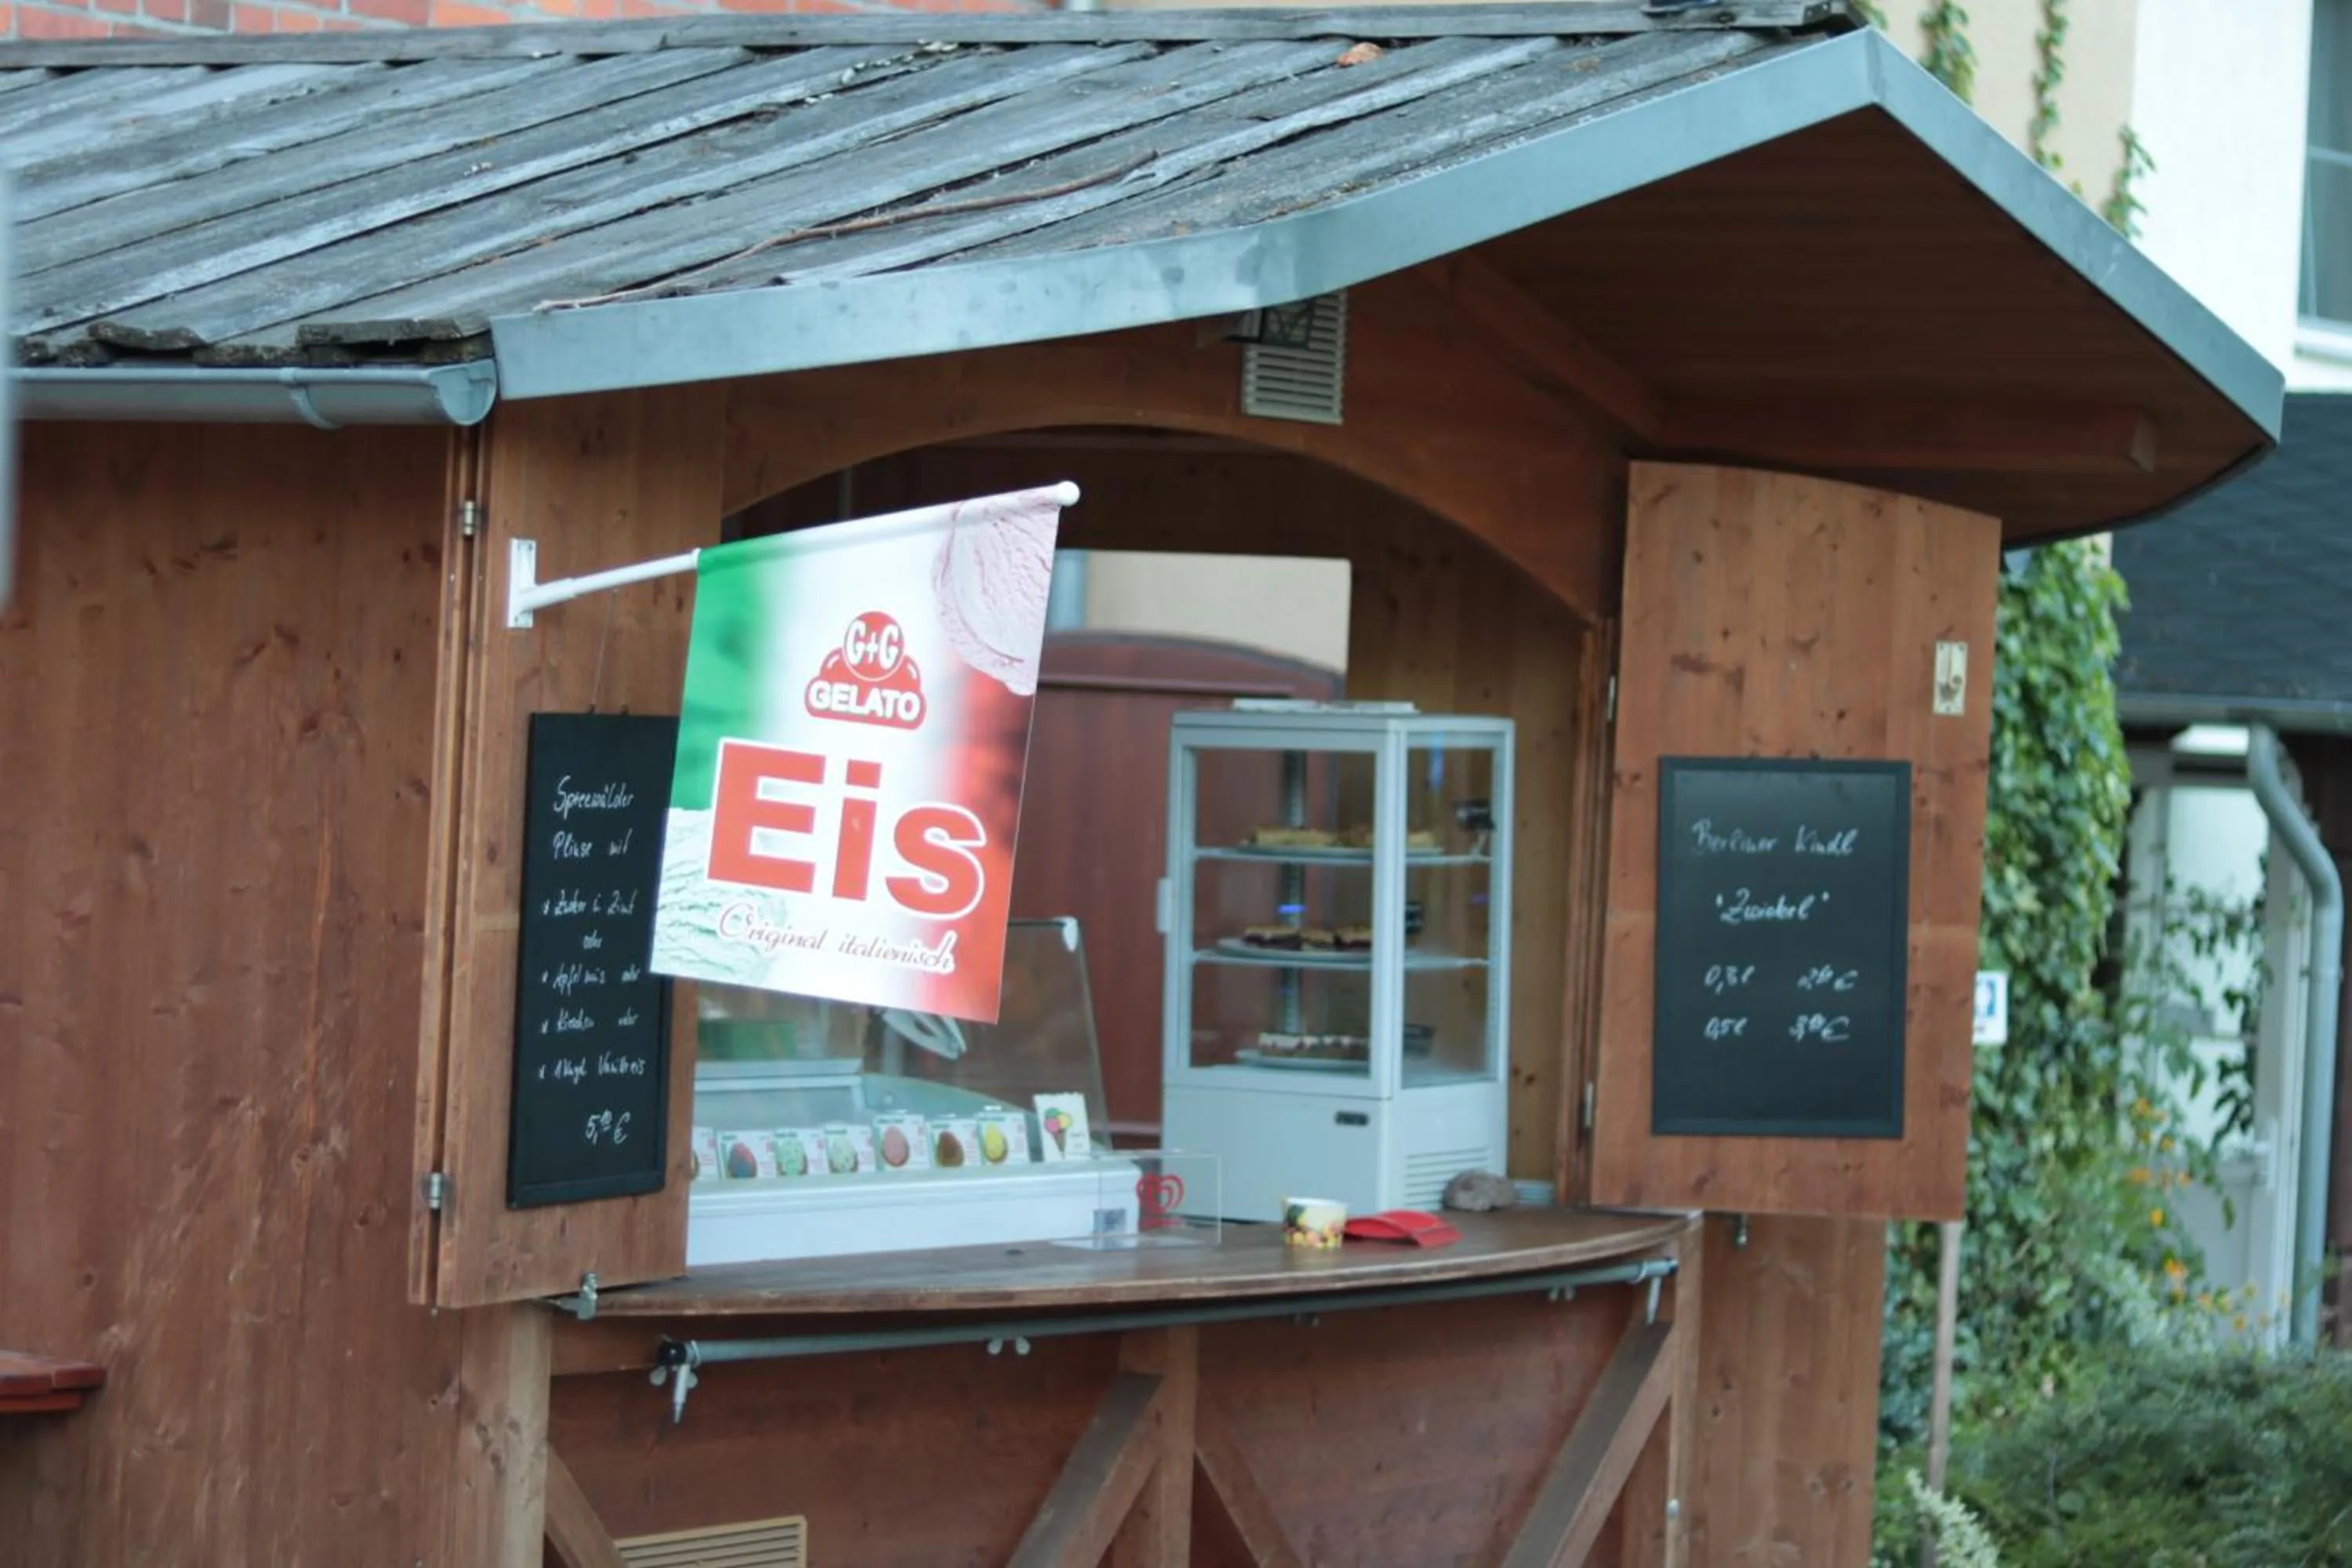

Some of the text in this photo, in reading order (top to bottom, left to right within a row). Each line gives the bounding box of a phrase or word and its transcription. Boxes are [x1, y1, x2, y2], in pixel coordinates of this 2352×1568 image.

[845, 619, 899, 670] G+G
[808, 680, 921, 721] GELATO
[706, 741, 986, 918] Eis
[719, 902, 953, 970] Original italienisch
